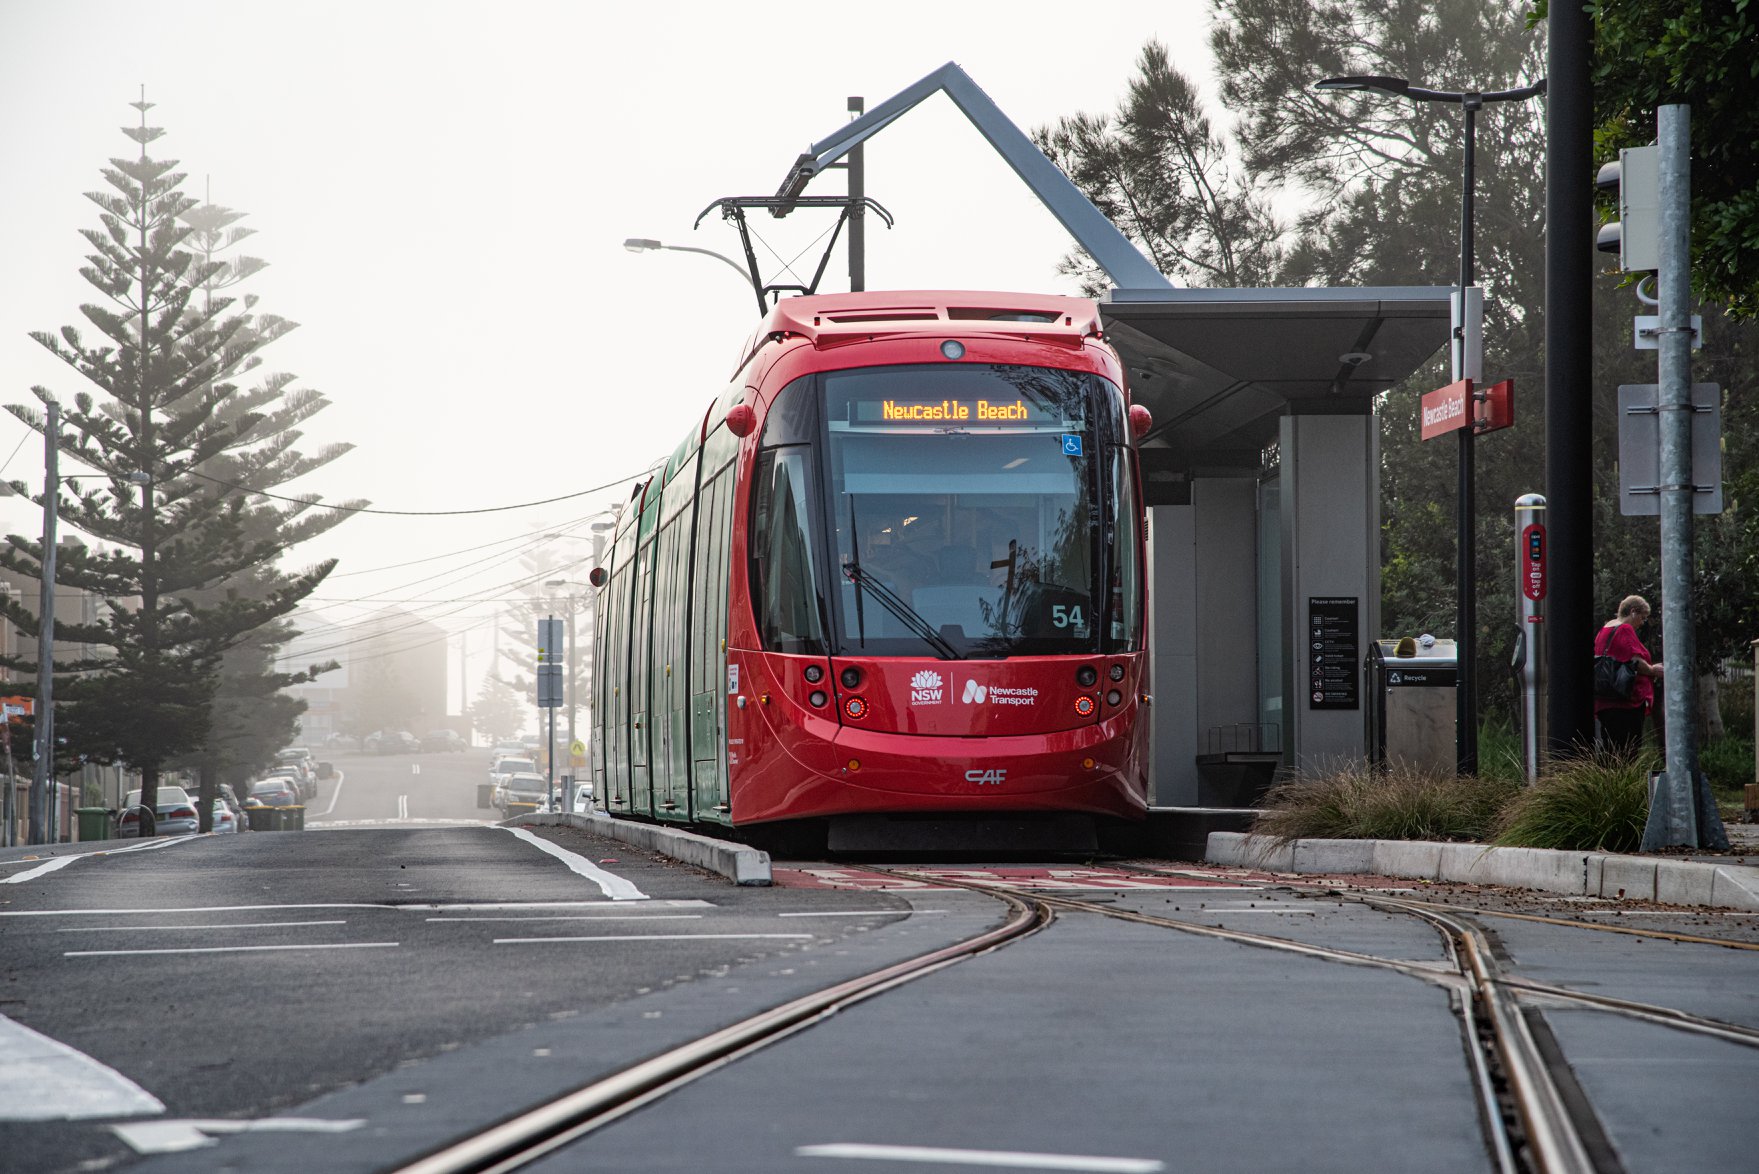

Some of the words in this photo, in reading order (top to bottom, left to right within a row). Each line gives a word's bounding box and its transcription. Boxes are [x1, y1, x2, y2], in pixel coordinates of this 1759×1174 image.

[883, 400, 969, 420] Newcastle
[977, 400, 1028, 420] Beach
[1423, 399, 1448, 427] Newcastle
[1448, 393, 1464, 418] Beach
[1052, 604, 1085, 628] 54
[911, 689, 943, 701] NSW
[989, 686, 1038, 697] Newcastle
[990, 695, 1035, 706] Transport
[964, 769, 1007, 785] CAF
